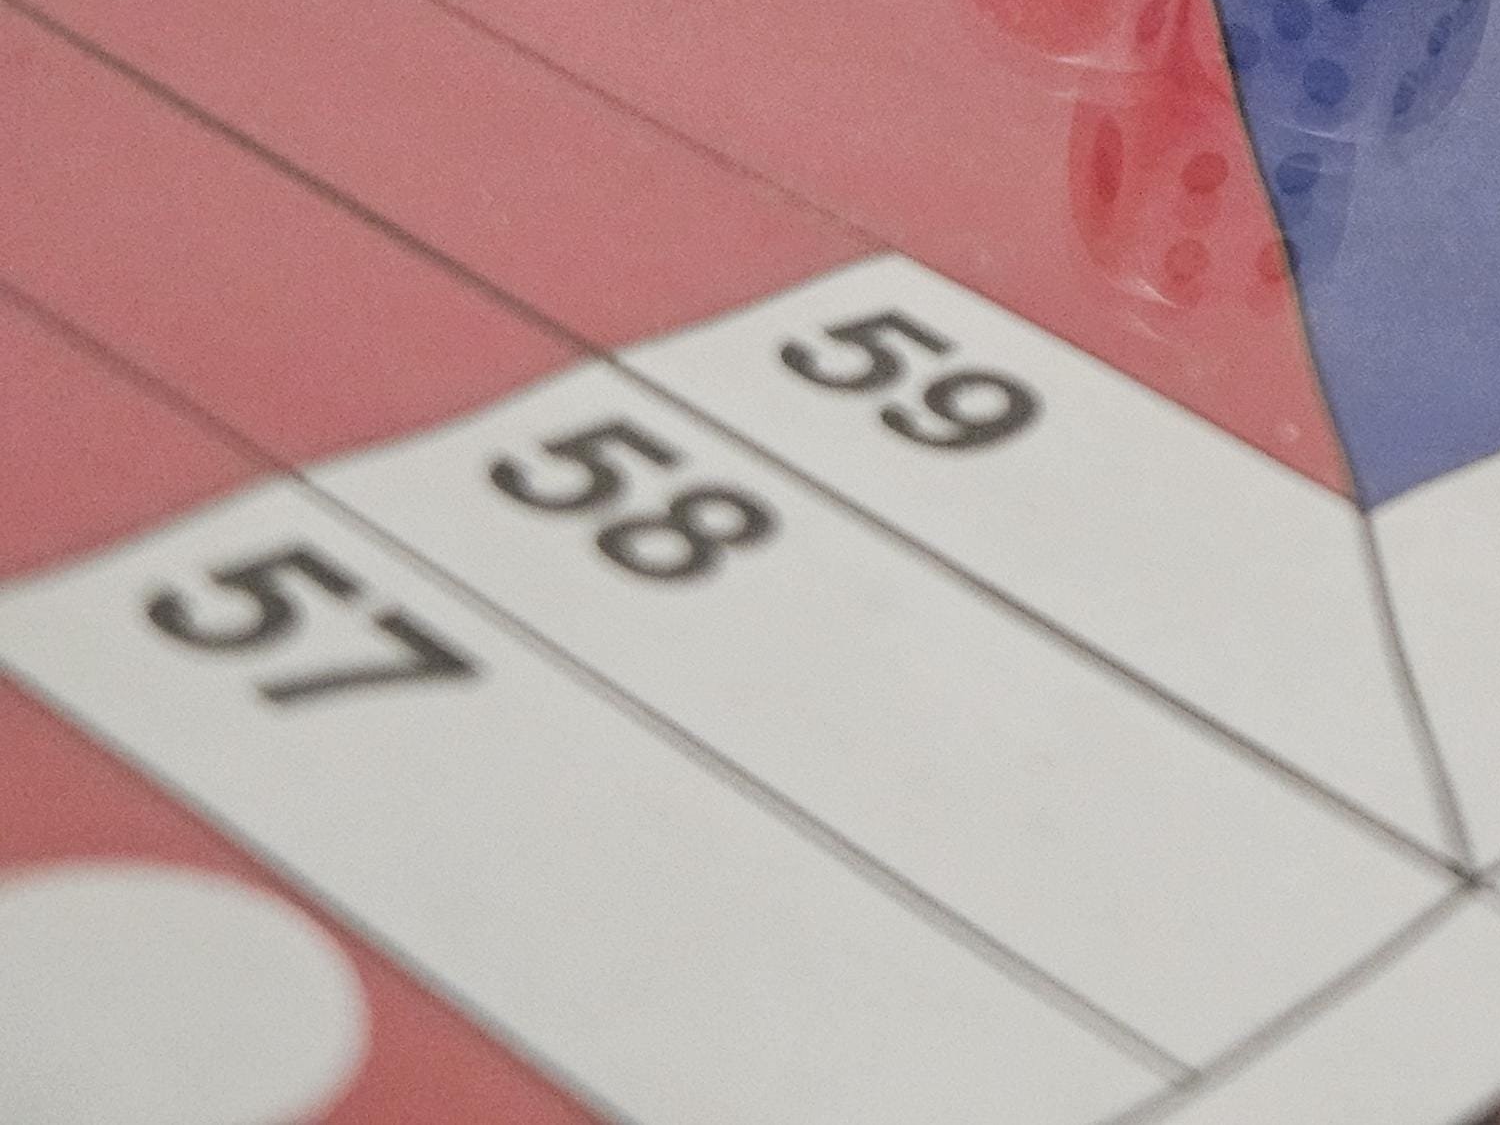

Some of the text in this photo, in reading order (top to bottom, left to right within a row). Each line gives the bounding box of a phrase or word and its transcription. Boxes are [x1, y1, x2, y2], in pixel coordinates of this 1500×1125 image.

[778, 309, 1046, 455] 59
[486, 413, 784, 587] 58
[144, 539, 482, 709] 57
